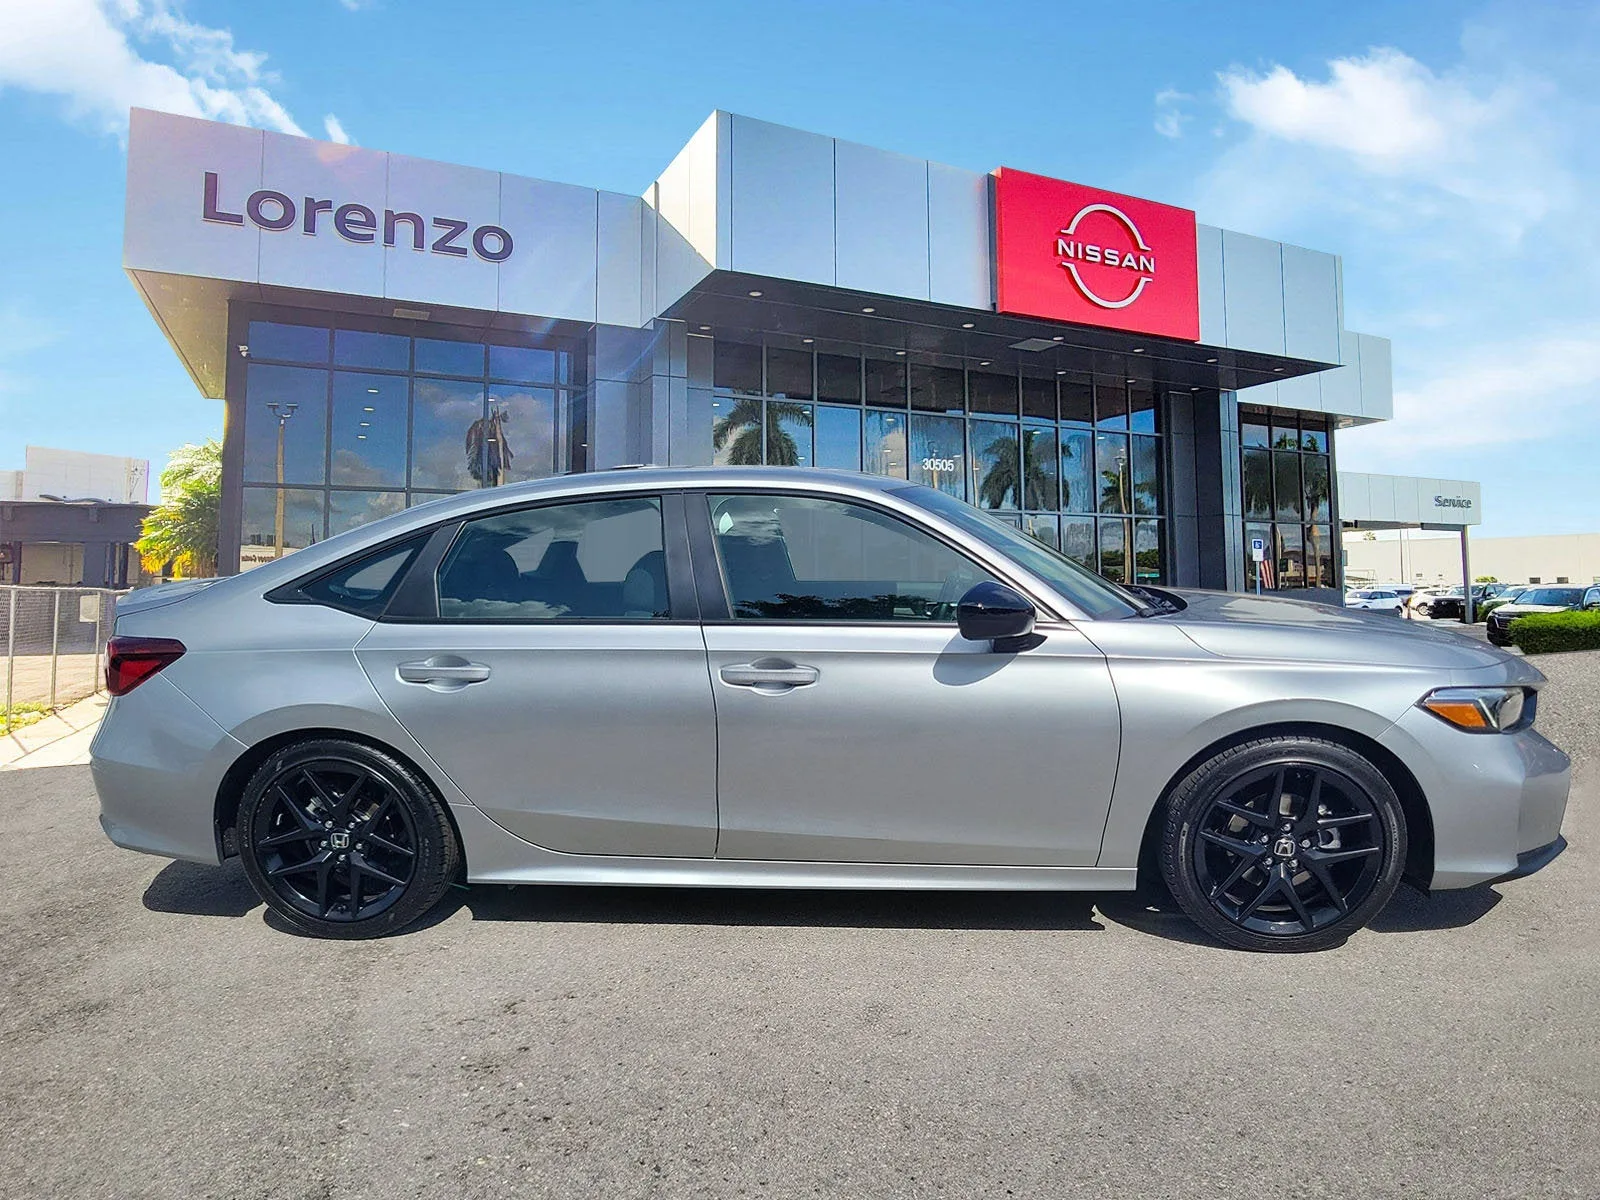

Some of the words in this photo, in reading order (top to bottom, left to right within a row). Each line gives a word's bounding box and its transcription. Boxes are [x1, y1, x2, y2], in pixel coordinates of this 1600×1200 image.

[202, 171, 514, 263] Lorenzo
[1057, 238, 1155, 273] NISSAN
[922, 457, 955, 472] 30505
[1434, 495, 1472, 508] Service
